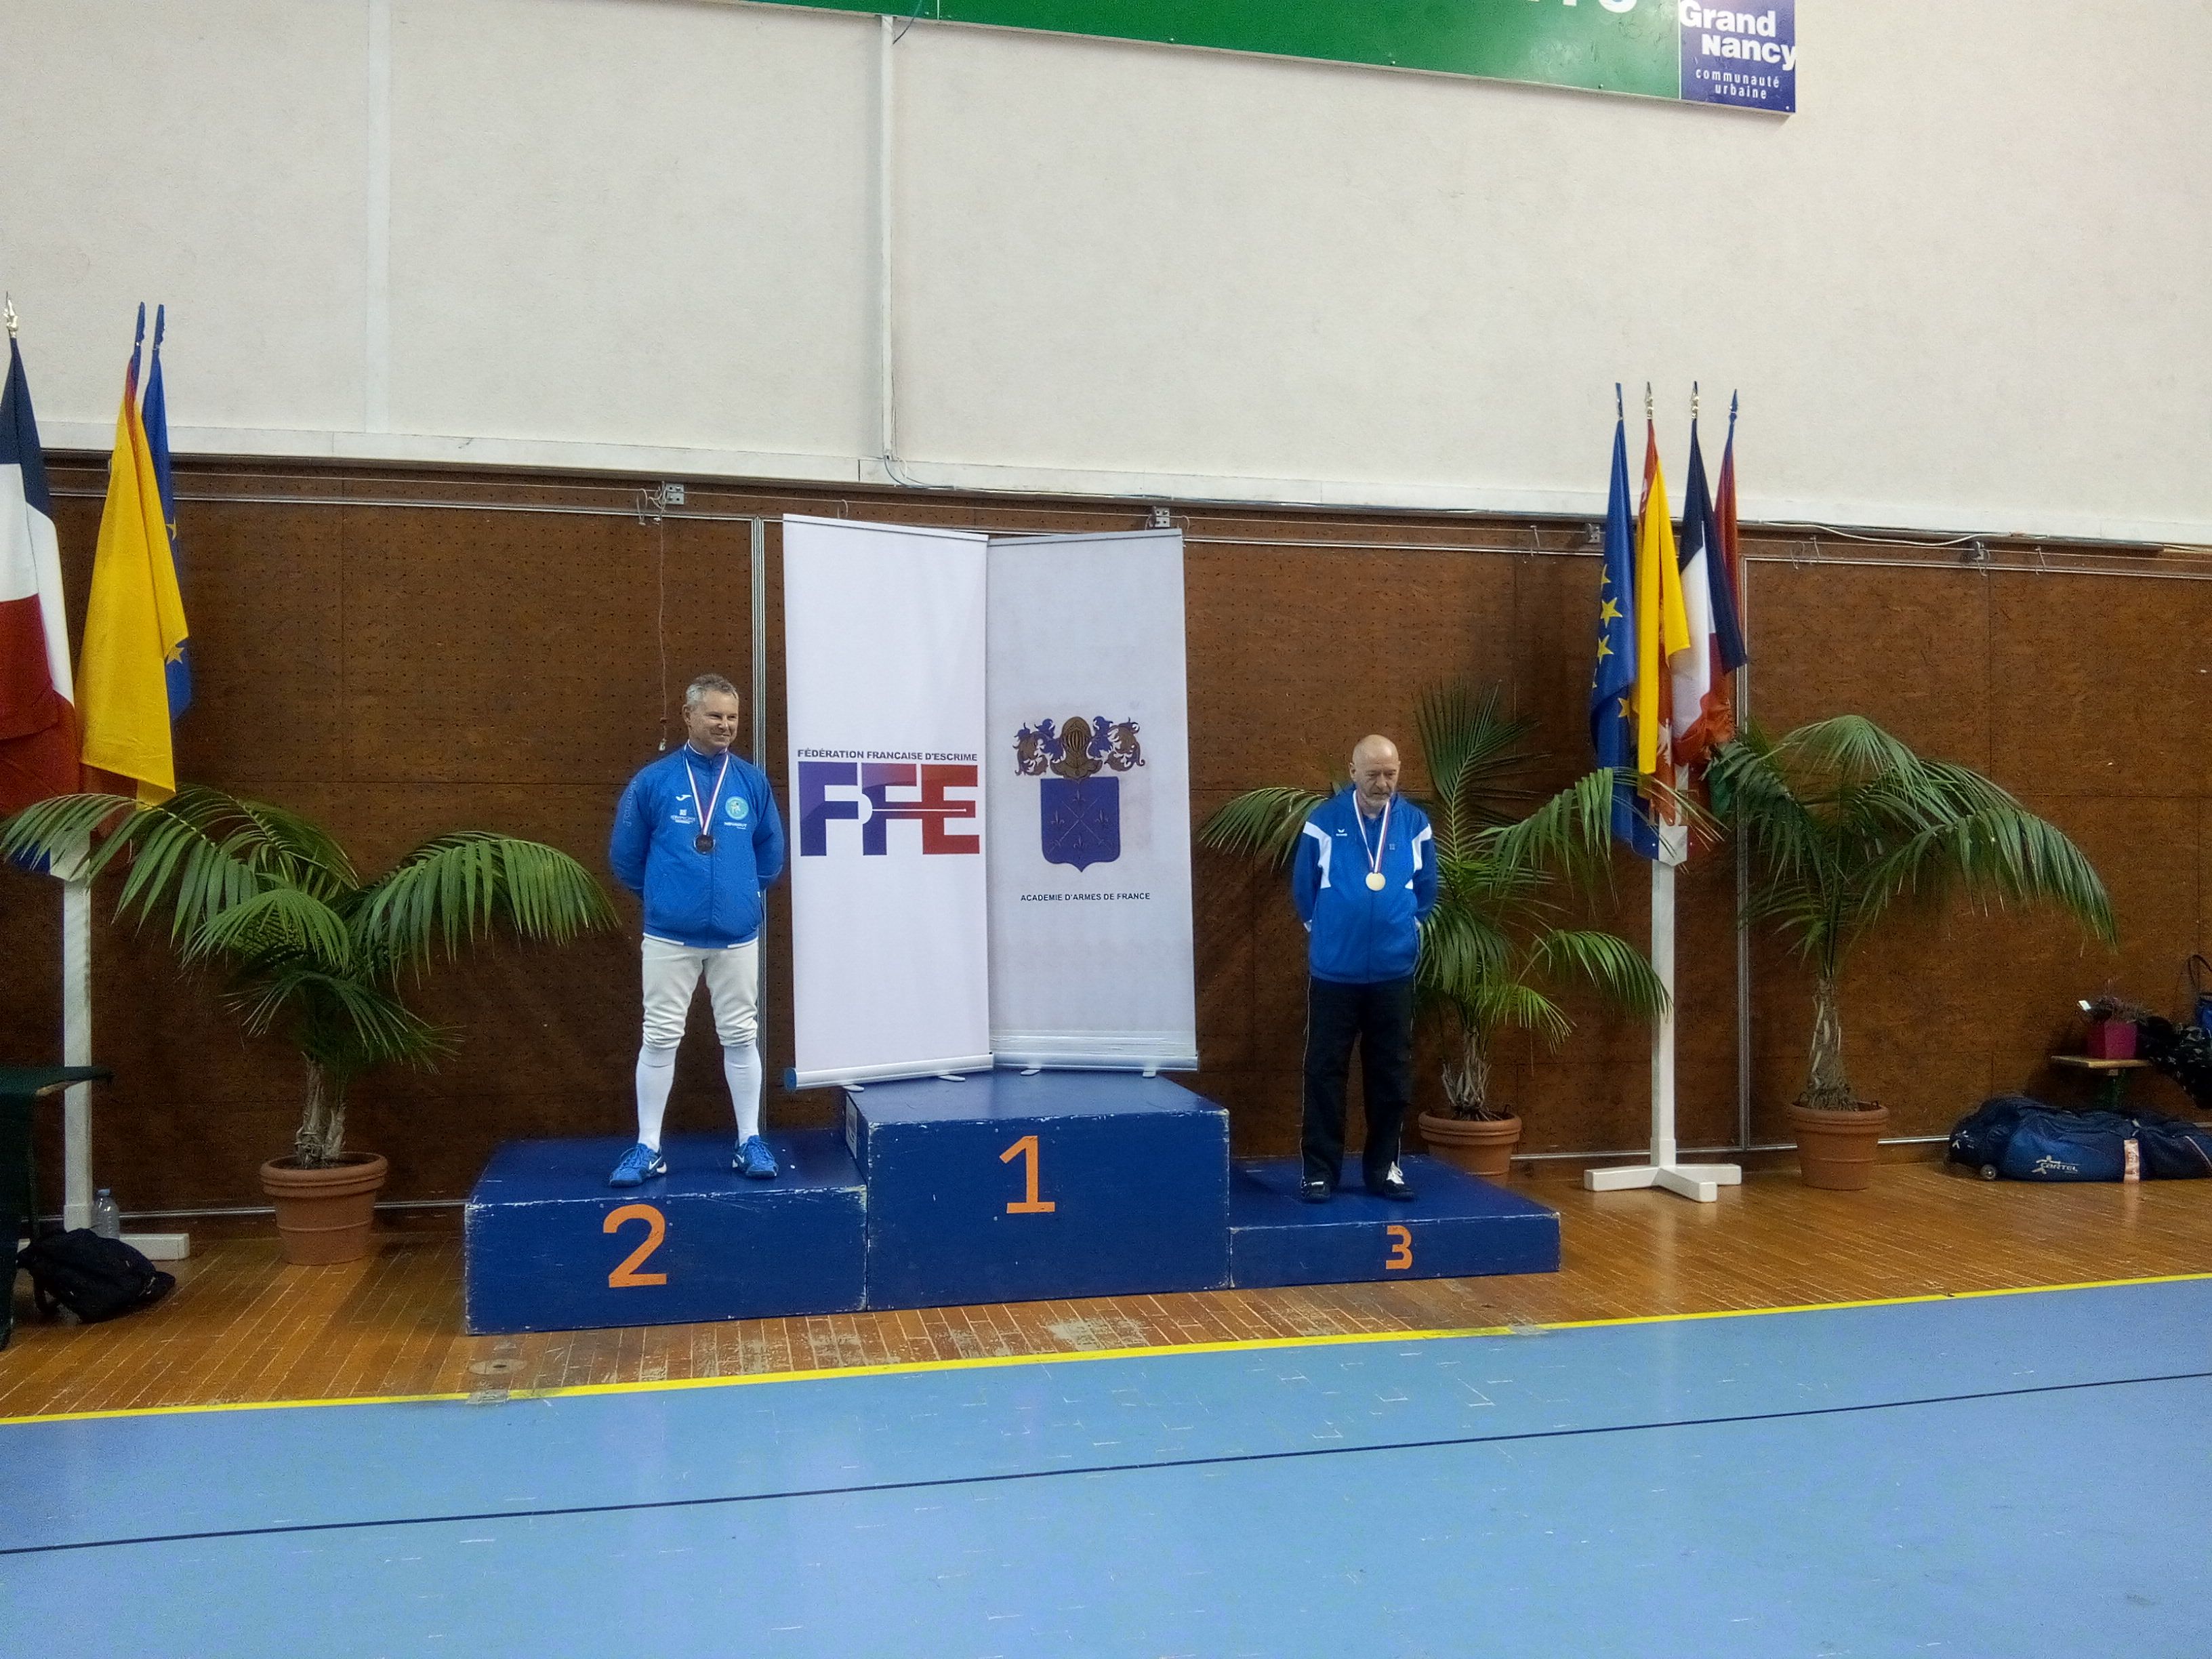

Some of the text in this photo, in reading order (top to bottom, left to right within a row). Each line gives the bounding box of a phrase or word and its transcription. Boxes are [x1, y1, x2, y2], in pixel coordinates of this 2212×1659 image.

[1679, 0, 1776, 37] Grand
[1702, 34, 1796, 71] Nancy
[1696, 68, 1780, 88] communauté
[1715, 83, 1767, 100] urbaine
[798, 747, 864, 759] FÉDÉRATION
[925, 753, 978, 761] D'ESCRIME
[798, 761, 980, 857] FFE
[1000, 1135, 1055, 1214] 1
[602, 1204, 668, 1288] 2
[1386, 1225, 1413, 1269] 3
